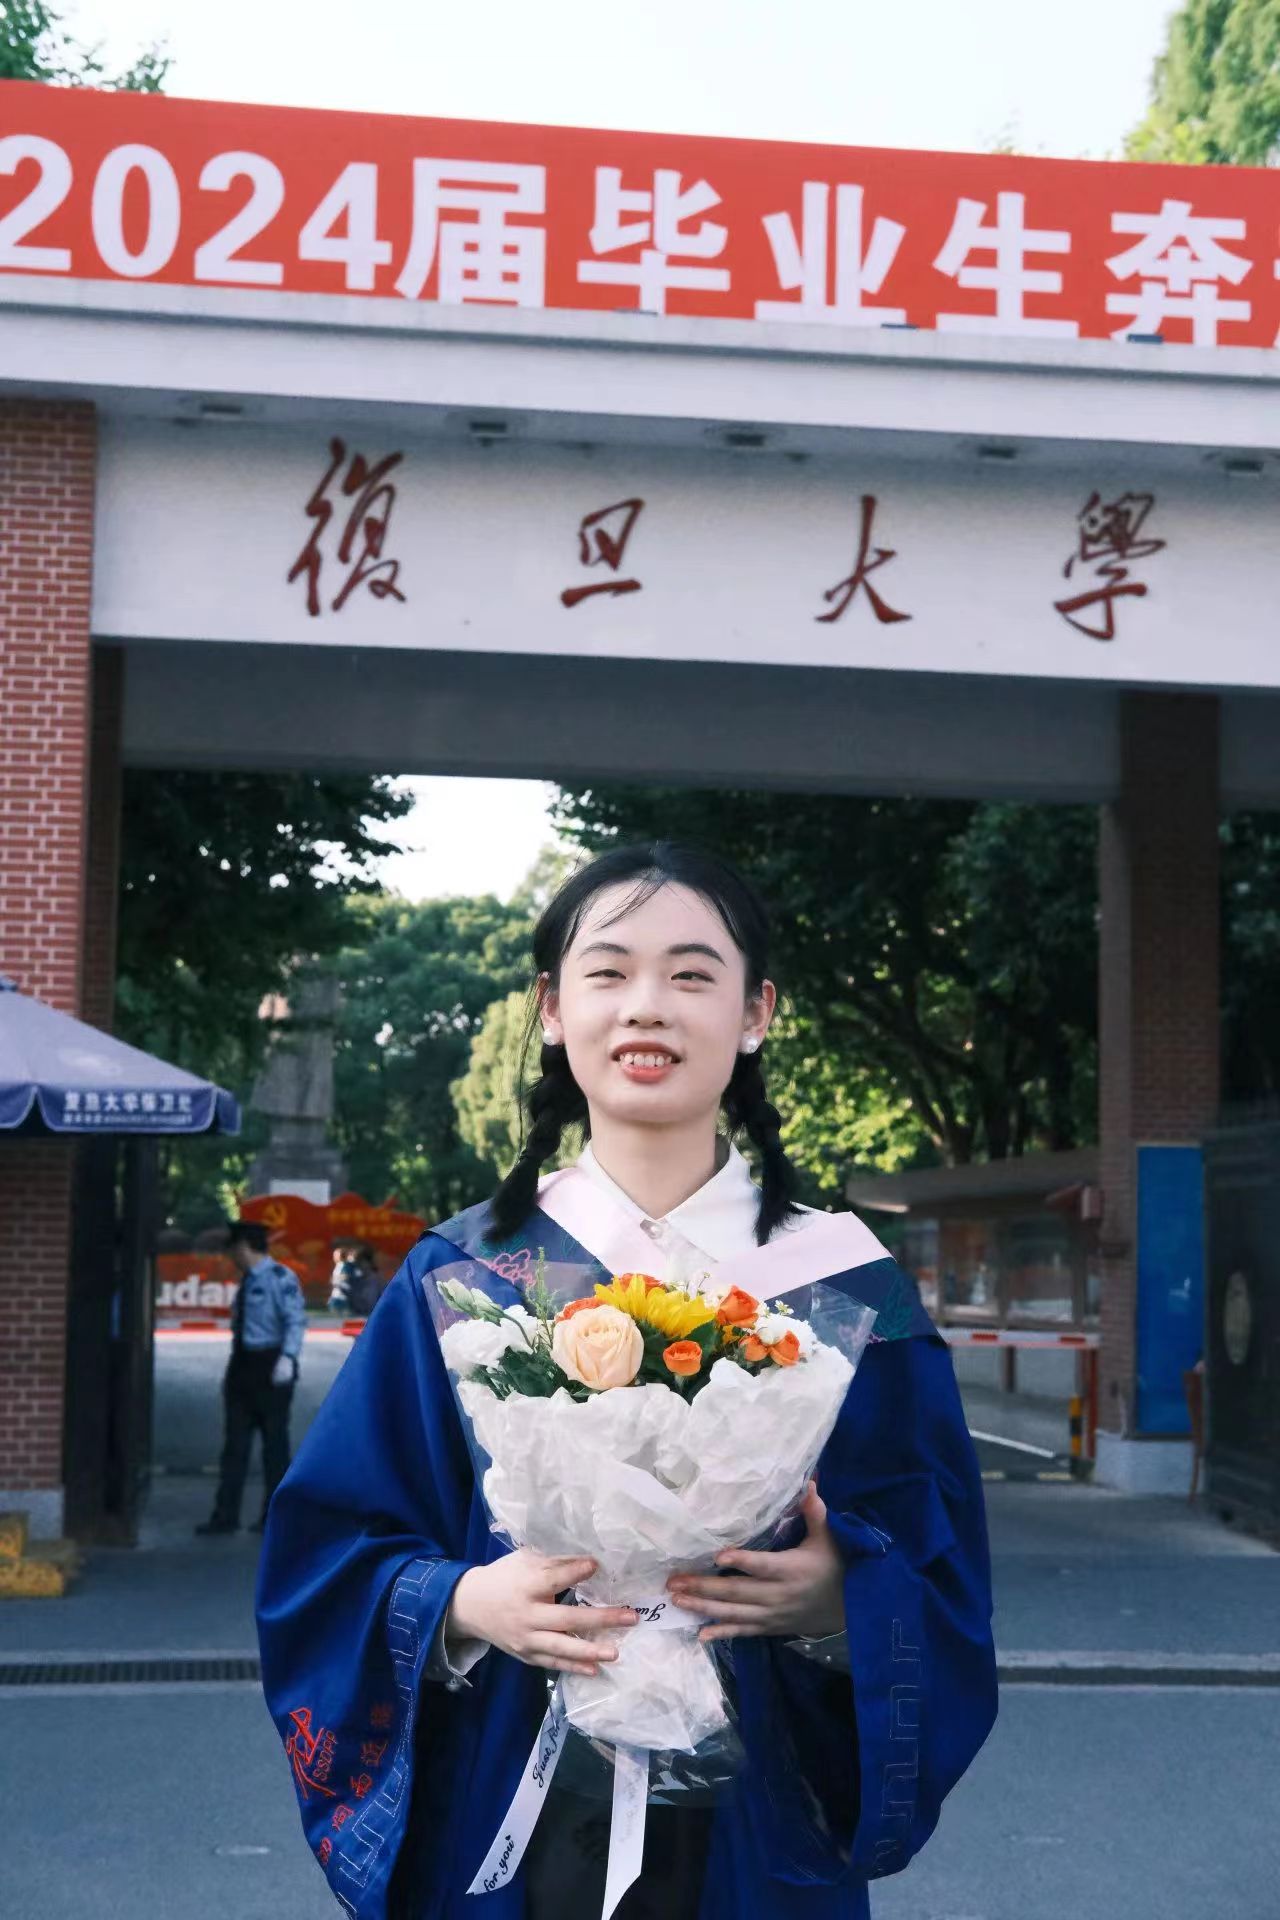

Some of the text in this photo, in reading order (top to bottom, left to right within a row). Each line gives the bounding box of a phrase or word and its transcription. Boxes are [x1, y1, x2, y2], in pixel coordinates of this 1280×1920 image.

[0, 133, 1280, 350] 2024届毕业生奔
[632, 1603, 666, 1622] Jus
[483, 1839, 516, 1891] for you
